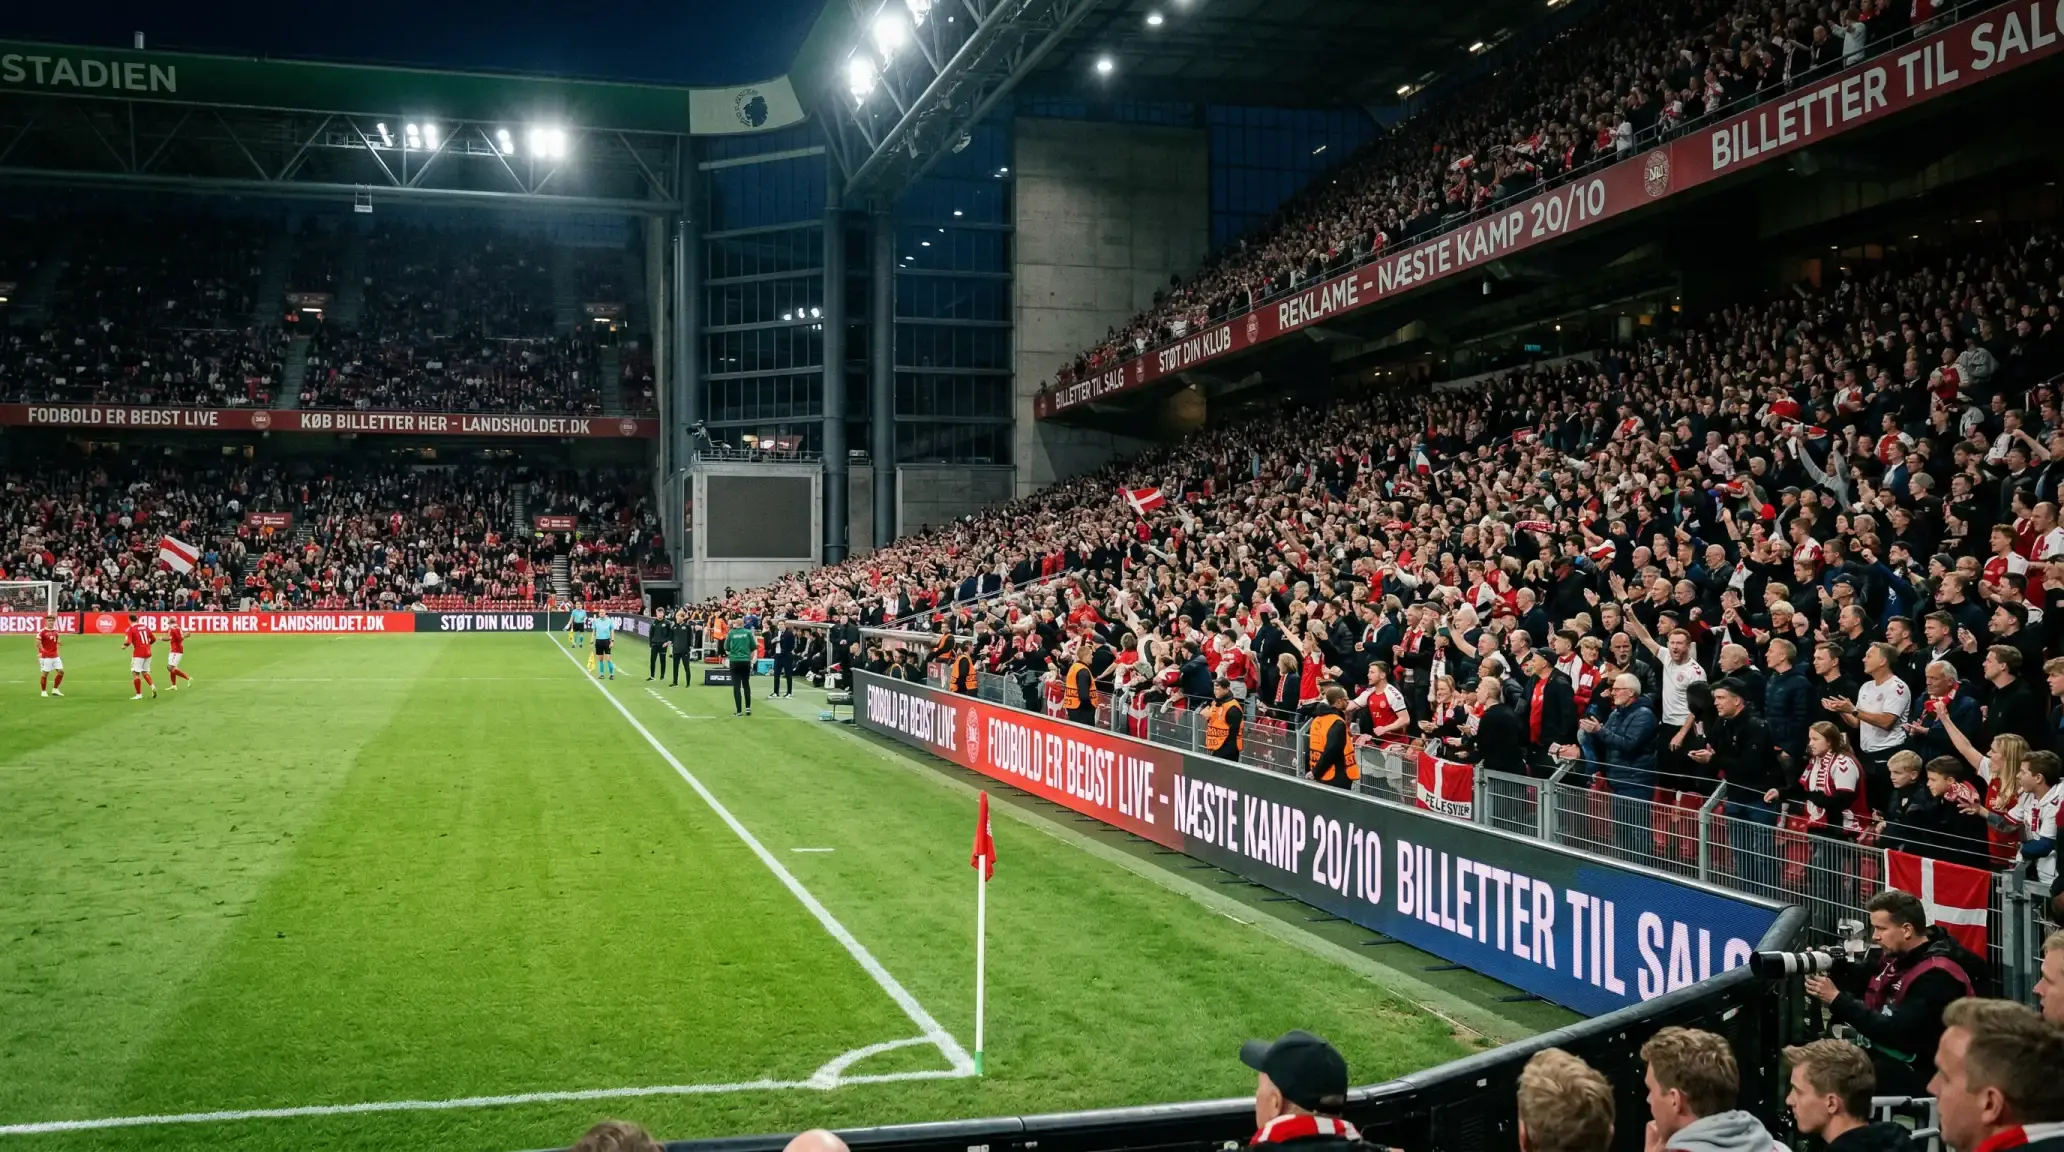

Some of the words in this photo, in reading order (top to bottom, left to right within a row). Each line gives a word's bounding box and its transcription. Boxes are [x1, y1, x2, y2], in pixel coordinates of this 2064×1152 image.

[1, 53, 177, 93] STADIEN
[1712, 66, 1888, 170] BILLETTER
[1898, 40, 1958, 97] TIL
[1971, 0, 2064, 70] SAL
[1279, 274, 1359, 330] REKLAME
[1363, 281, 1373, 290] -
[1378, 238, 1451, 294] NÆSTE
[1457, 211, 1524, 265] KAMP
[1531, 179, 1605, 238] 20/10
[1159, 344, 1181, 372] STØT
[1184, 338, 1200, 364] DIN
[1202, 326, 1231, 357] KLUB
[1056, 382, 1091, 409] BILLETTER
[1091, 377, 1103, 396] TIL
[1104, 367, 1124, 392] SALG
[28, 407, 101, 424] FODBOLD
[106, 409, 126, 425] ER
[130, 409, 181, 426] BEDST
[185, 411, 218, 426] LIVE
[301, 413, 332, 429] KØB
[336, 414, 414, 431] BILLETTER
[418, 417, 447, 431] HER
[462, 418, 590, 434] LANDSHOLDET.DK
[0, 616, 43, 632] BEDST
[233, 616, 258, 631] HER
[271, 615, 385, 632] LANDSHOLDET.DK
[441, 614, 472, 632] STØT
[476, 615, 497, 631] DIN
[501, 615, 534, 631] KLUB
[867, 684, 898, 729] FODBOLD
[899, 692, 909, 733] ER
[910, 695, 936, 742] BEDST
[937, 703, 957, 751] LIVE
[987, 717, 1043, 782] FODBOLD
[1045, 734, 1063, 791] ER
[1067, 739, 1115, 808] BEDST
[1119, 753, 1155, 824] LIVE
[1159, 794, 1169, 805] -
[1174, 774, 1238, 852] NÆSTE
[1244, 794, 1306, 874] KAMP
[1312, 815, 1382, 905] 20/10
[1397, 839, 1556, 970] BILLETTER
[1566, 889, 1626, 996] TIL
